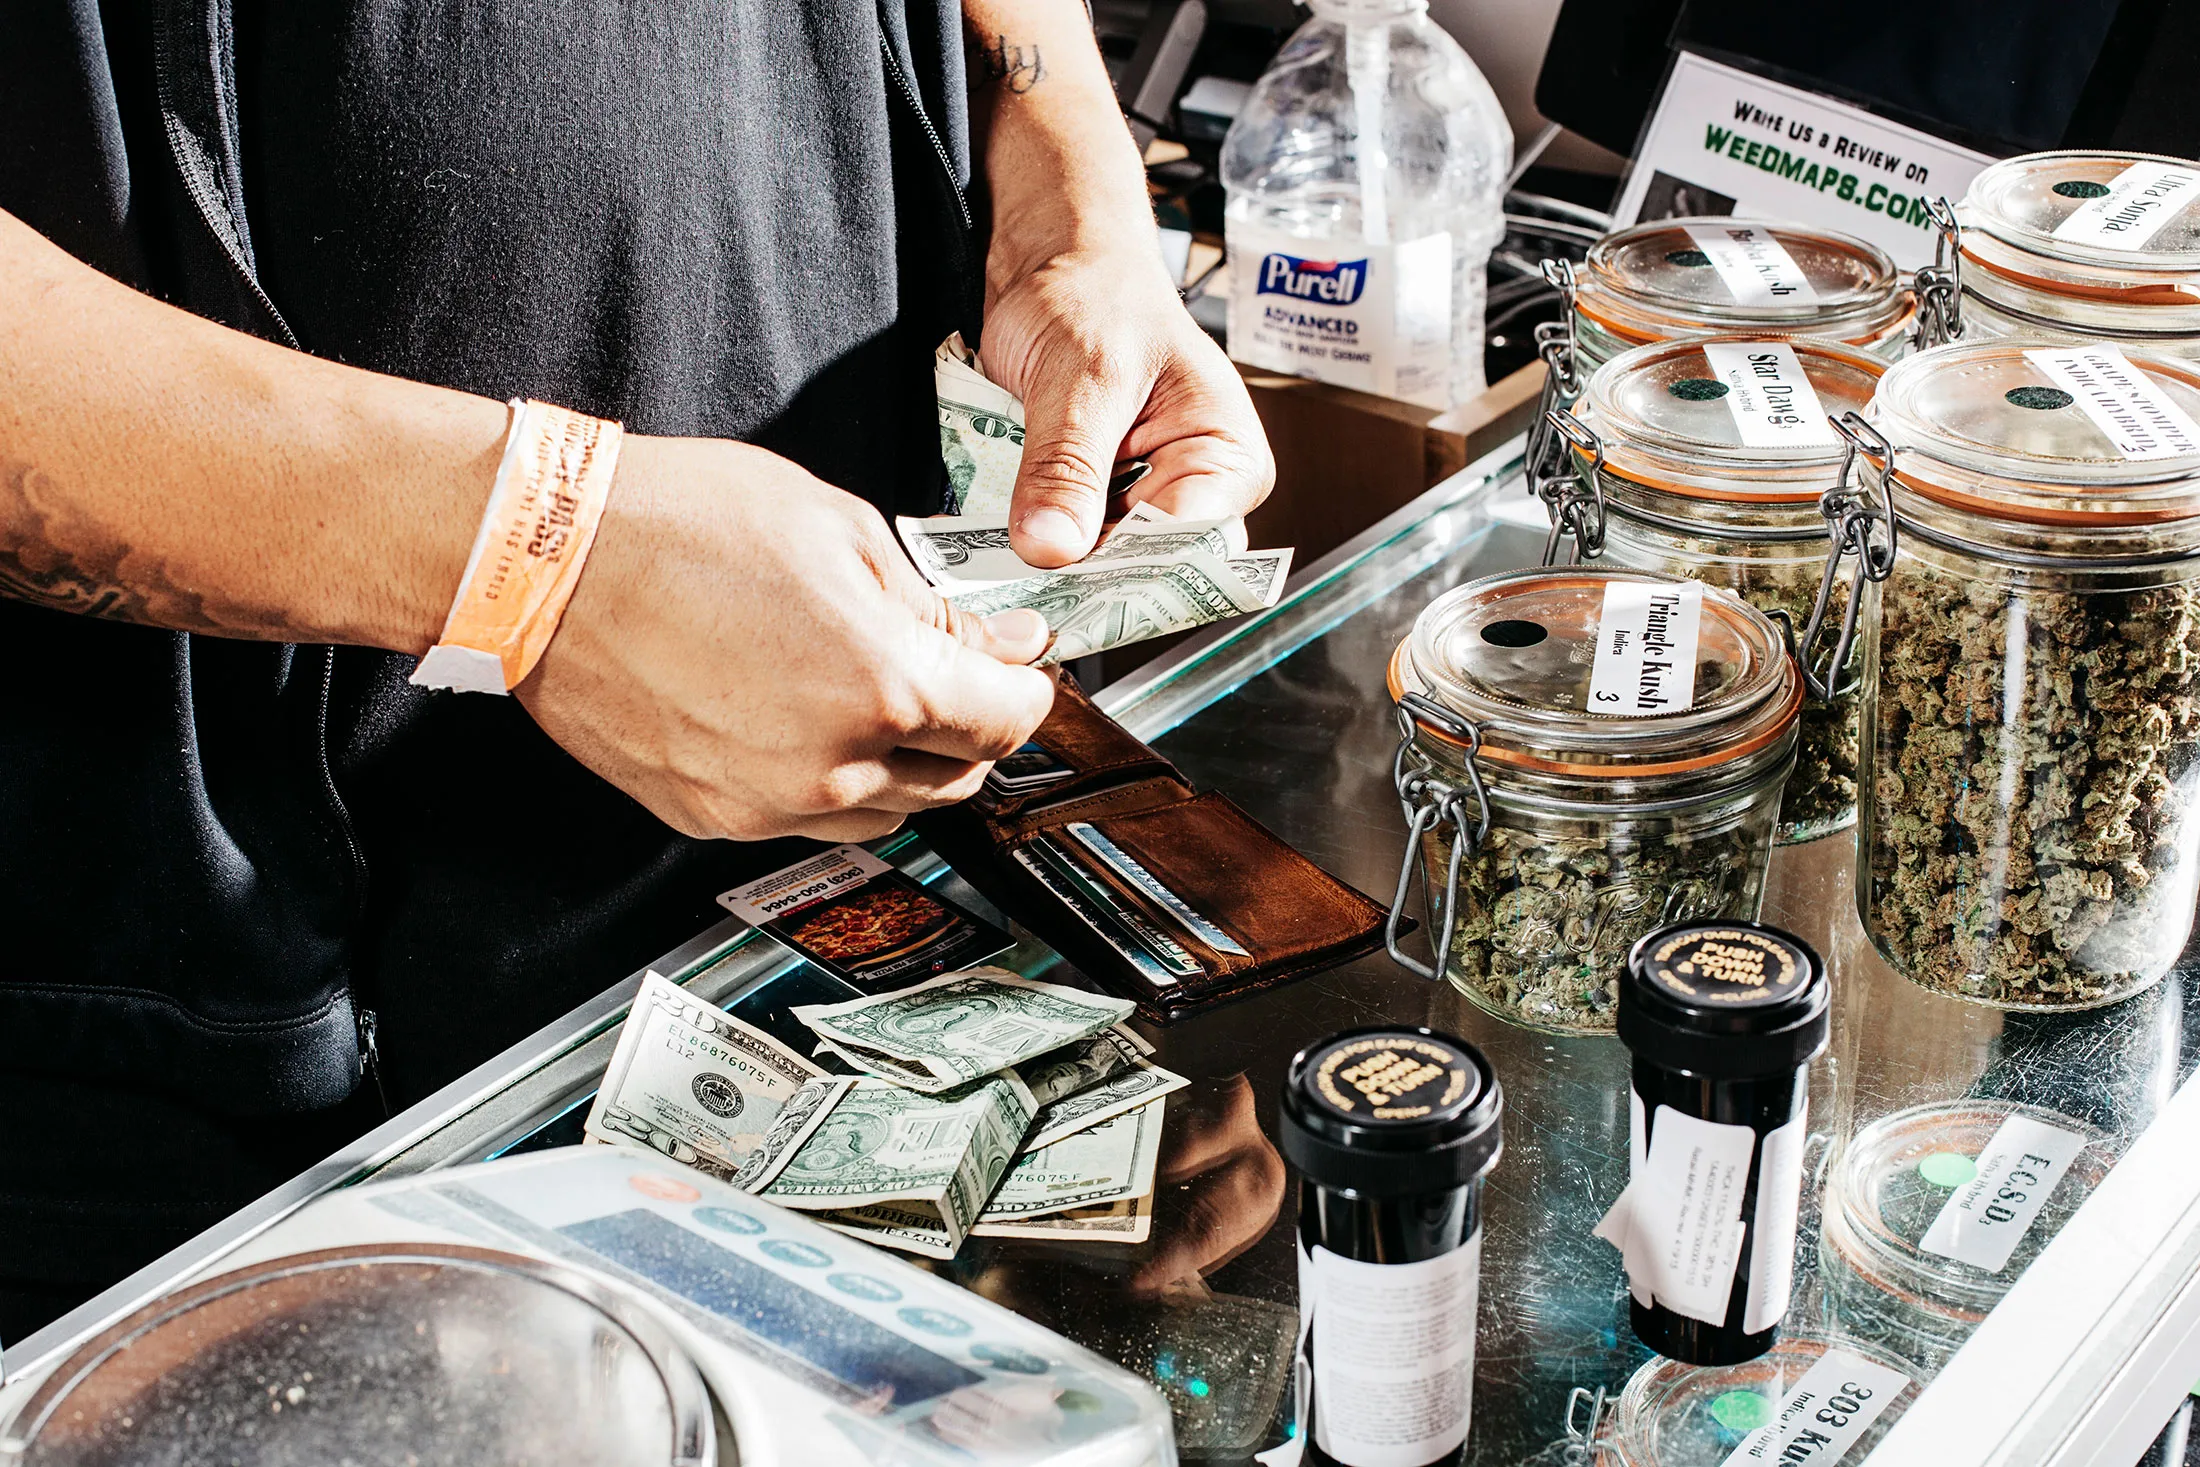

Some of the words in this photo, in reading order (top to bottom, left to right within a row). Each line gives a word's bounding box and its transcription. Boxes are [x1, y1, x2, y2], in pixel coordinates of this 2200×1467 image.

[1704, 123, 1932, 231] WEEDMAPS.COM
[2141, 173, 2194, 198] Ultra
[2101, 199, 2162, 232] Sonja
[1265, 254, 1359, 303] Purell
[1754, 264, 1797, 296] Kush
[1264, 306, 1359, 336] ADVANCED
[1747, 353, 1782, 381] Star
[2083, 354, 2137, 391] GRAPE
[1762, 385, 1803, 425] Dawg
[2055, 359, 2109, 397] INDICA
[2097, 399, 2159, 449] HYBRID
[1637, 593, 1680, 657] Triangle
[1612, 629, 1631, 656] Indica
[1595, 690, 1620, 703] 3
[1637, 660, 1673, 709] Kush
[826, 866, 865, 885] (303)
[1690, 951, 1764, 974] DOWN
[1701, 942, 1765, 963] PUSH
[873, 967, 892, 977] PIZZA
[1701, 964, 1766, 986] TURN
[665, 1039, 696, 1062] L12
[1959, 1177, 1989, 1211] Hybrid
[1780, 1391, 1816, 1422] Indica
[1815, 1381, 1873, 1429] 303
[1748, 1423, 1788, 1459] Hybrid
